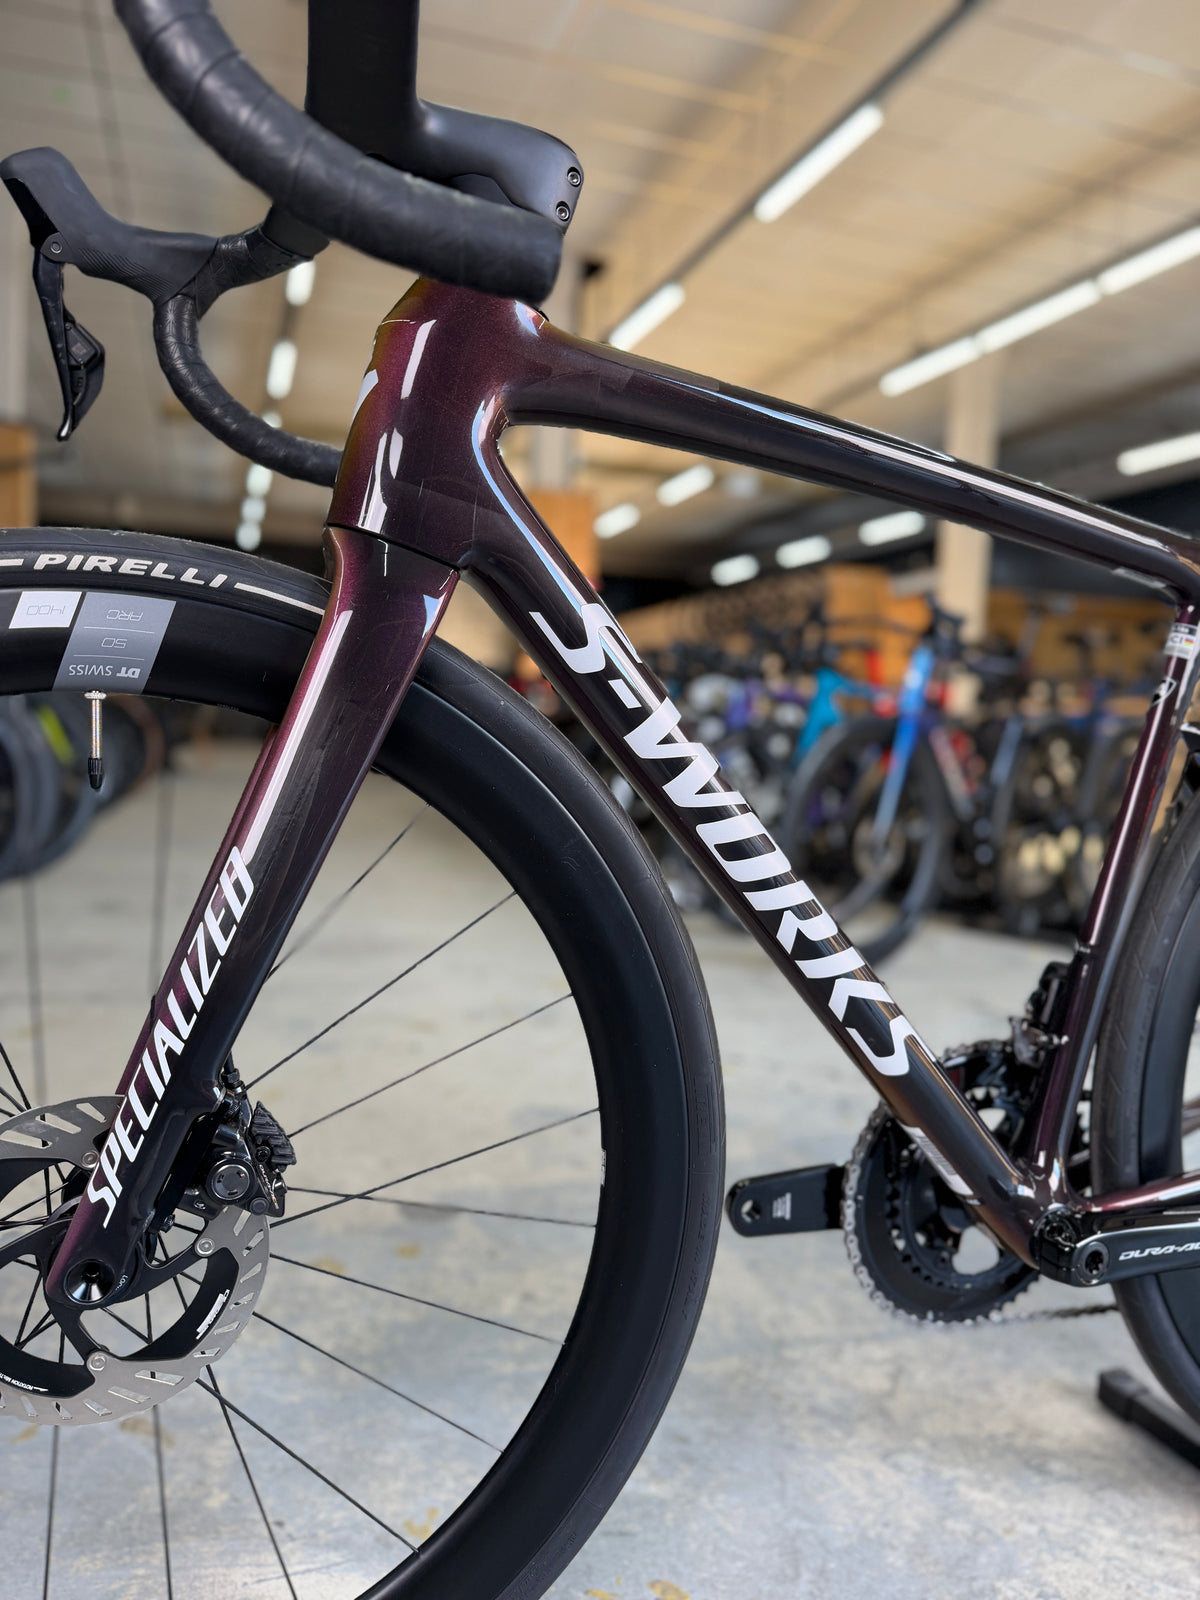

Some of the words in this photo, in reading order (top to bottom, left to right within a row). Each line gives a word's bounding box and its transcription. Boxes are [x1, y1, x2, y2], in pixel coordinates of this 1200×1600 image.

[33, 553, 229, 589] PIRELLI
[26, 604, 66, 616] 1400
[106, 609, 144, 622] ARC
[101, 637, 128, 649] 50
[68, 663, 114, 677] SWISS
[116, 666, 142, 679] DT
[529, 602, 938, 1077] S-WORKS
[86, 845, 255, 1229] SPECIALIZED
